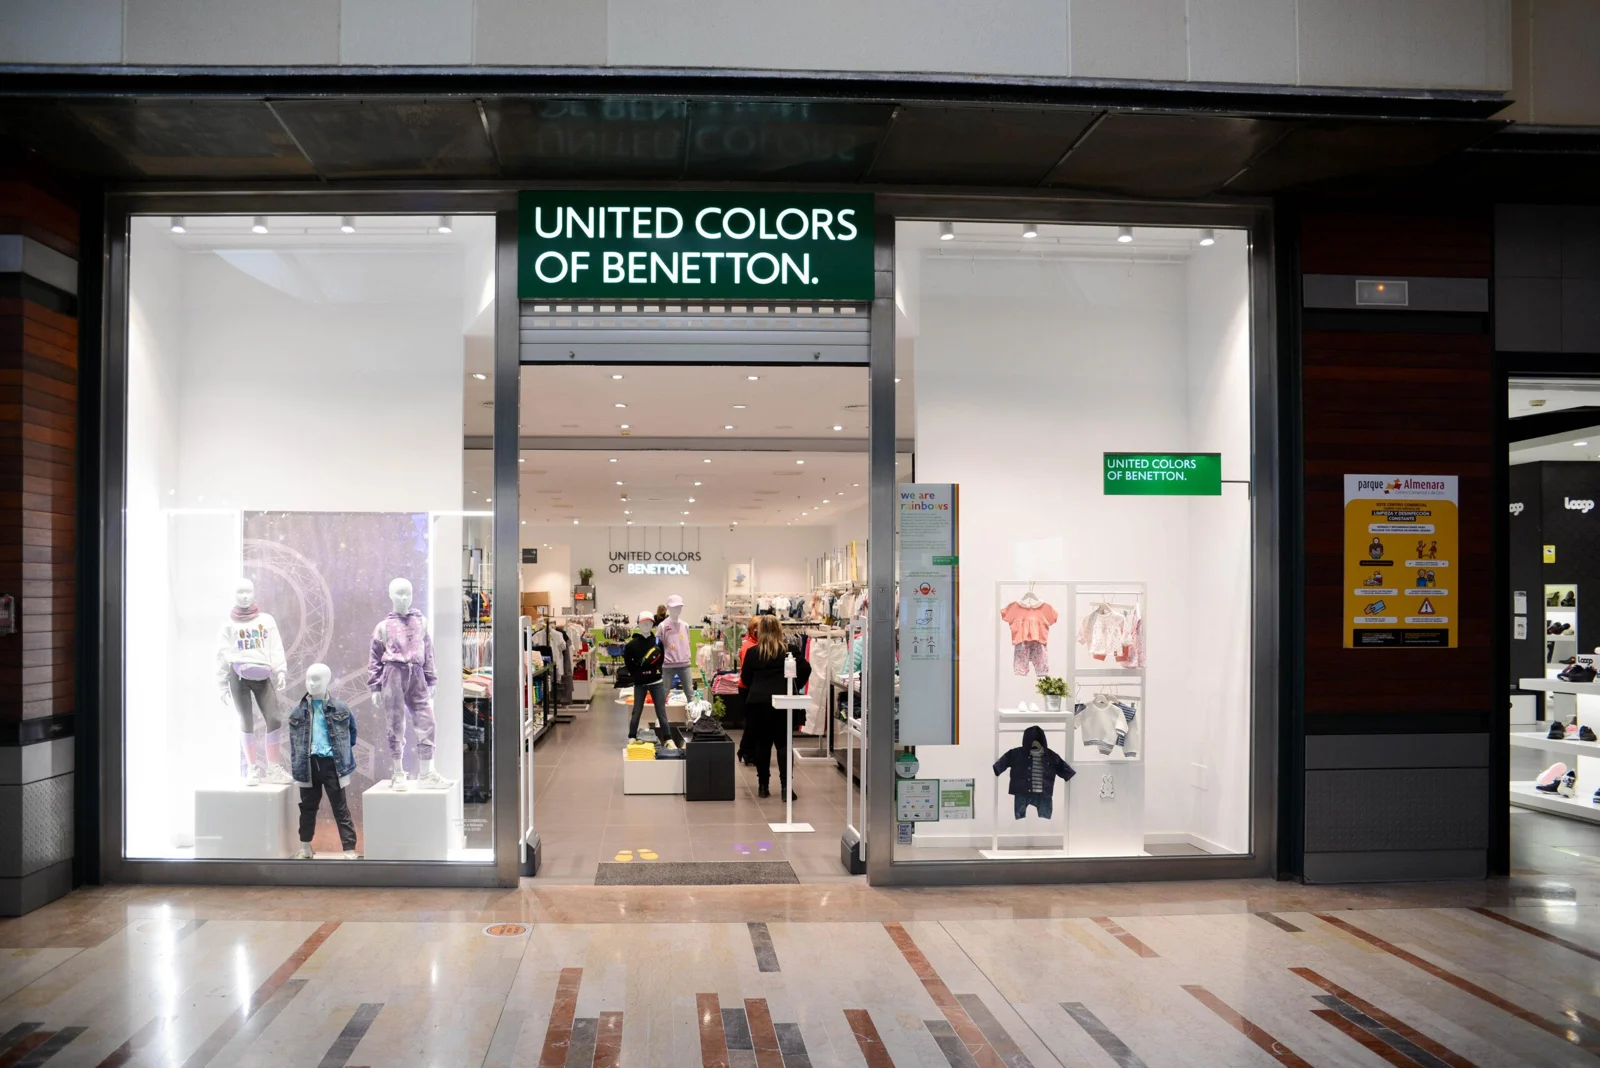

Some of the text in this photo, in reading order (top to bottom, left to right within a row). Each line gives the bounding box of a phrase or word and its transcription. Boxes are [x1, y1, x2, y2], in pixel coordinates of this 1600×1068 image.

[534, 206, 858, 241] UNITED COLORS
[534, 251, 820, 285] OF BENETTON.
[1107, 459, 1197, 469] UNITED COLORS
[1107, 471, 1187, 481] OF BENETTON.
[1358, 479, 1445, 491] parque Almenara
[900, 492, 935, 500] we are
[900, 501, 949, 511] rainbows
[608, 551, 702, 562] UNITED COLORS
[608, 563, 690, 575] OF BENETTON.
[235, 624, 269, 639] OSMIC
